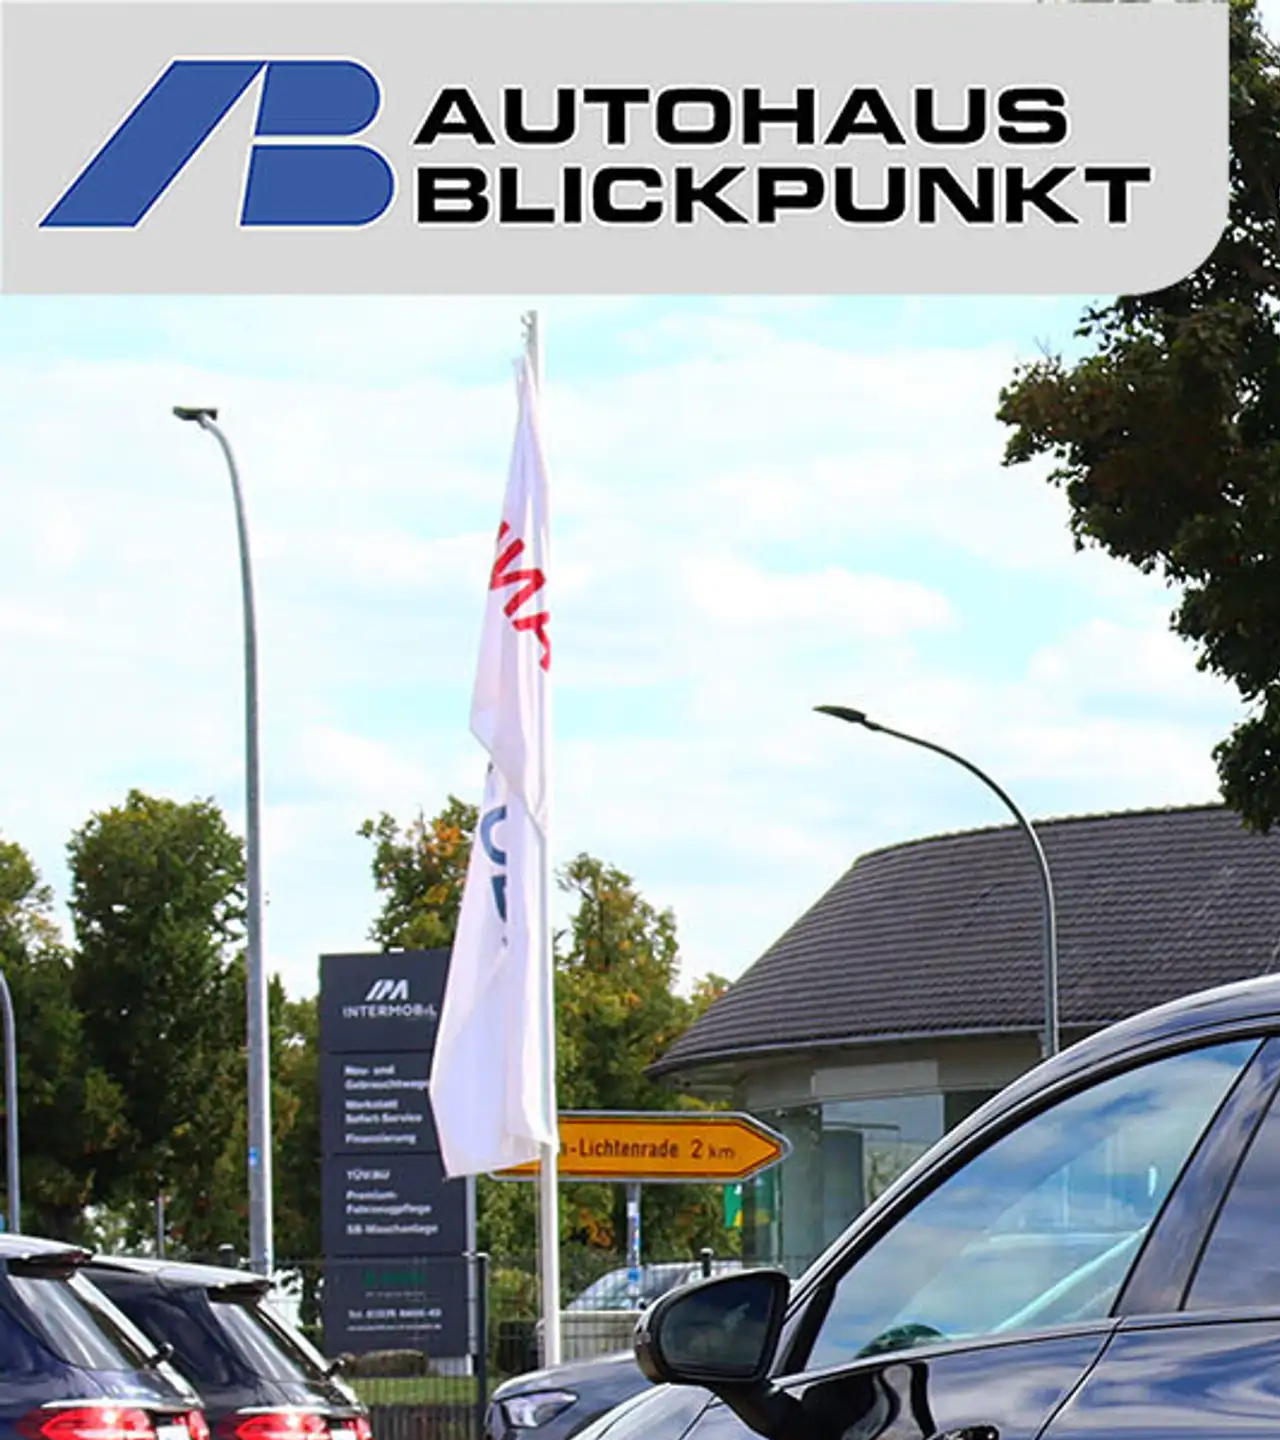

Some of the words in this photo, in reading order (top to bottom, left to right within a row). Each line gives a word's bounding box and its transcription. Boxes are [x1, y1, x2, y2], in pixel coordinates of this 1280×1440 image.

[345, 1079, 429, 1091] Gebrauchtwage
[691, 1139, 703, 1159] 2
[709, 1144, 736, 1160] km
